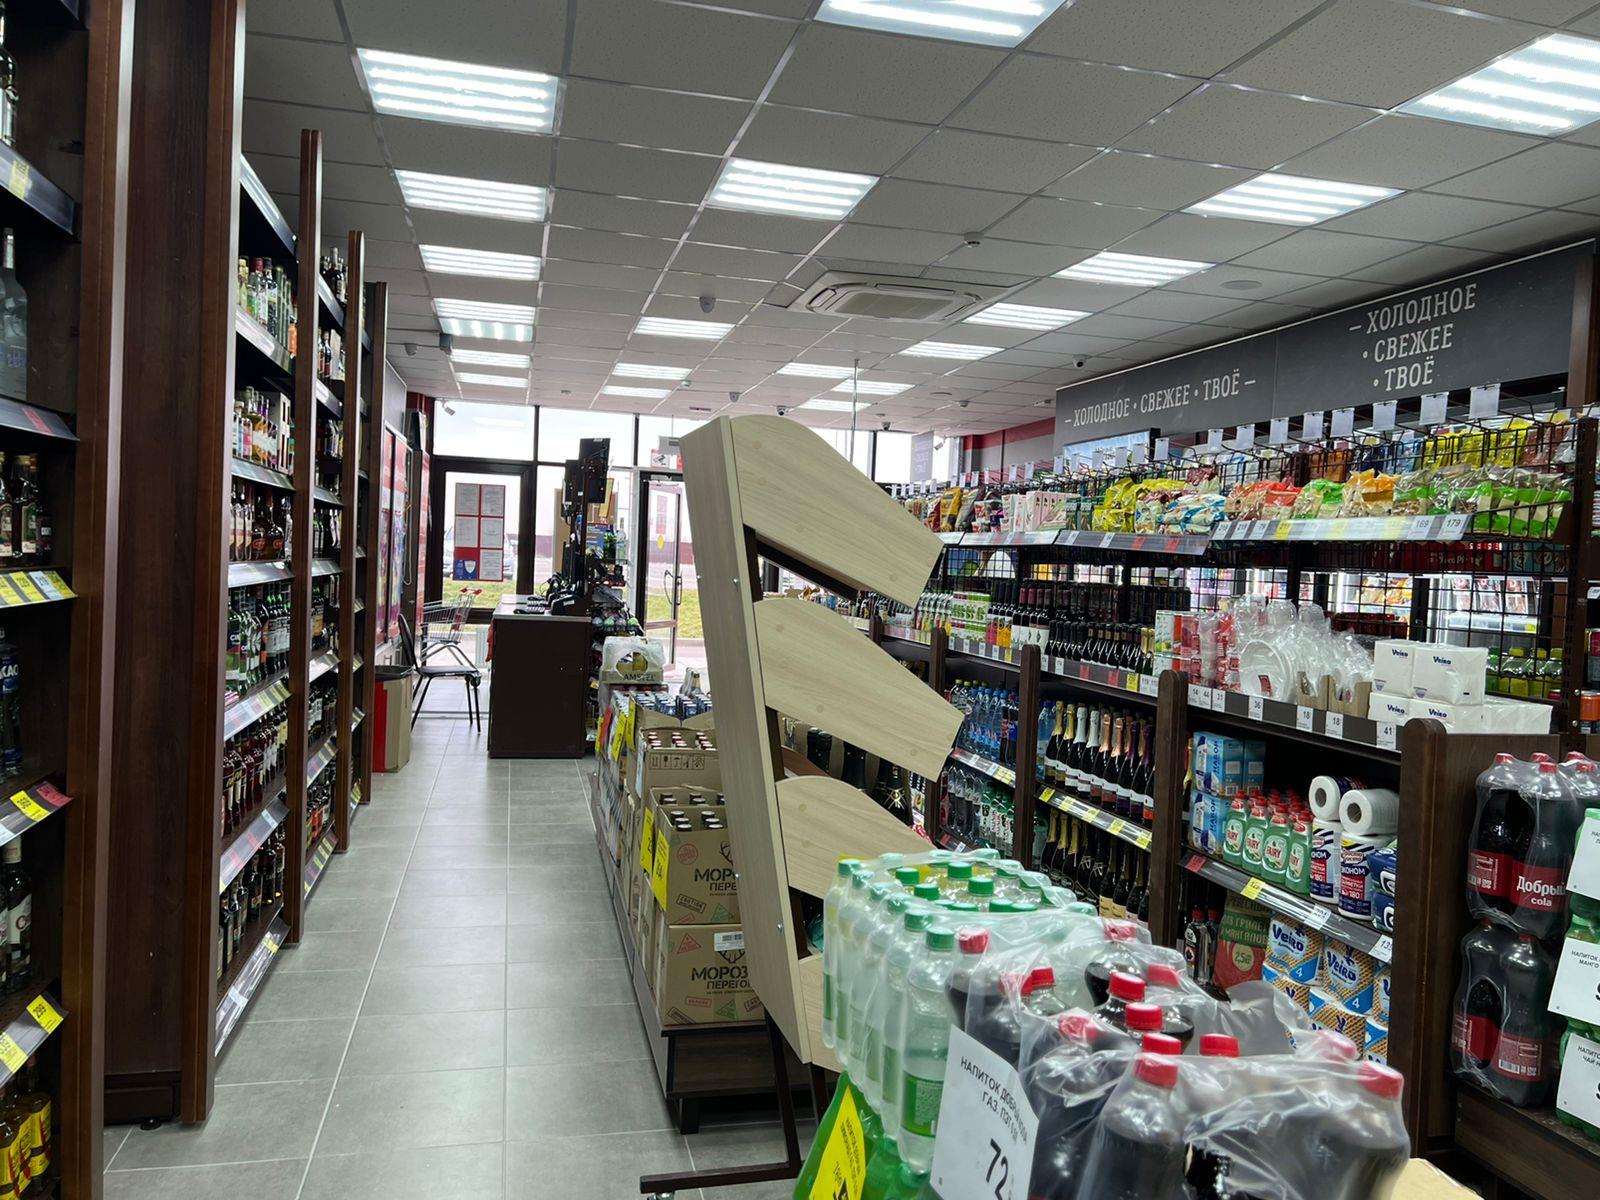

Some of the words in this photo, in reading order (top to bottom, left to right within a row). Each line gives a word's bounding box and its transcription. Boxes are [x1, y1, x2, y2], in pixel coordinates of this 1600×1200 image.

[1366, 283, 1477, 334] ХОЛОДНОЕ
[1374, 323, 1454, 362] СВЕЖЕЕ
[1384, 356, 1435, 391] ТВОЁ
[1073, 398, 1130, 427] ХОЛОДНОЕ
[1140, 384, 1190, 413] СВЕЖЕЕ
[1203, 369, 1240, 401] ТВОЁ
[1384, 726, 1392, 736] 41
[694, 868, 737, 882] МОР
[1530, 897, 1552, 907] cola
[1272, 924, 1304, 952] Veiro
[1296, 967, 1303, 977] 4
[1326, 951, 1357, 981] Veiro
[1579, 959, 1600, 969] МАНГО
[1352, 997, 1360, 1009] 4
[1582, 1055, 1596, 1064] ЧАЙ
[960, 1056, 1002, 1095] НАПИТОК
[982, 1091, 1000, 1114] ГАЗ.
[986, 1137, 1008, 1200] 72
